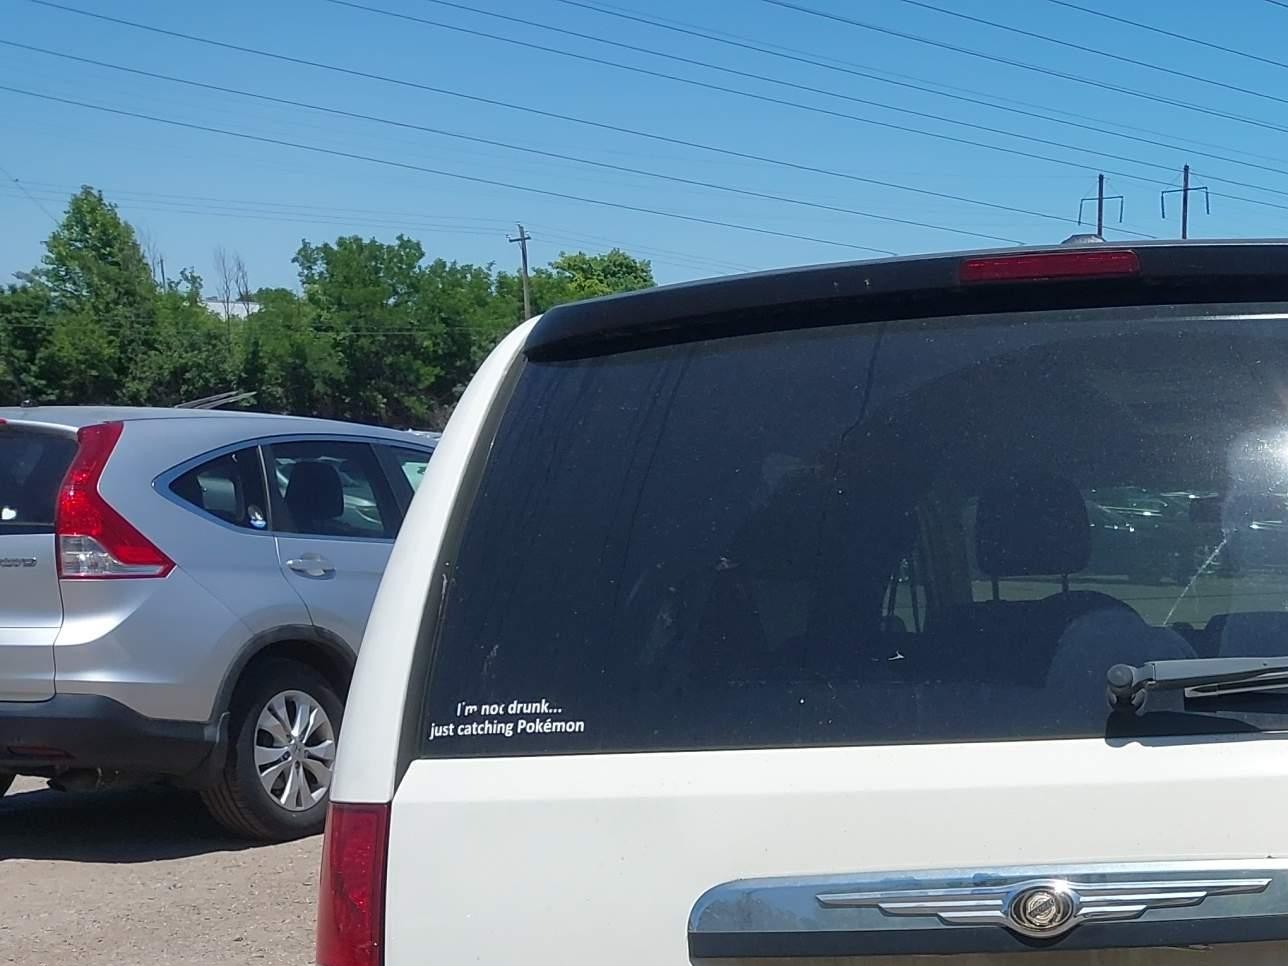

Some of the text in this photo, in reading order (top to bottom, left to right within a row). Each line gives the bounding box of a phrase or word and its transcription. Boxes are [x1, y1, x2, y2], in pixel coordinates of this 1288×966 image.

[456, 702, 478, 717] I'm
[508, 699, 562, 715] drunk...
[429, 719, 585, 740] just catching Pokémon
